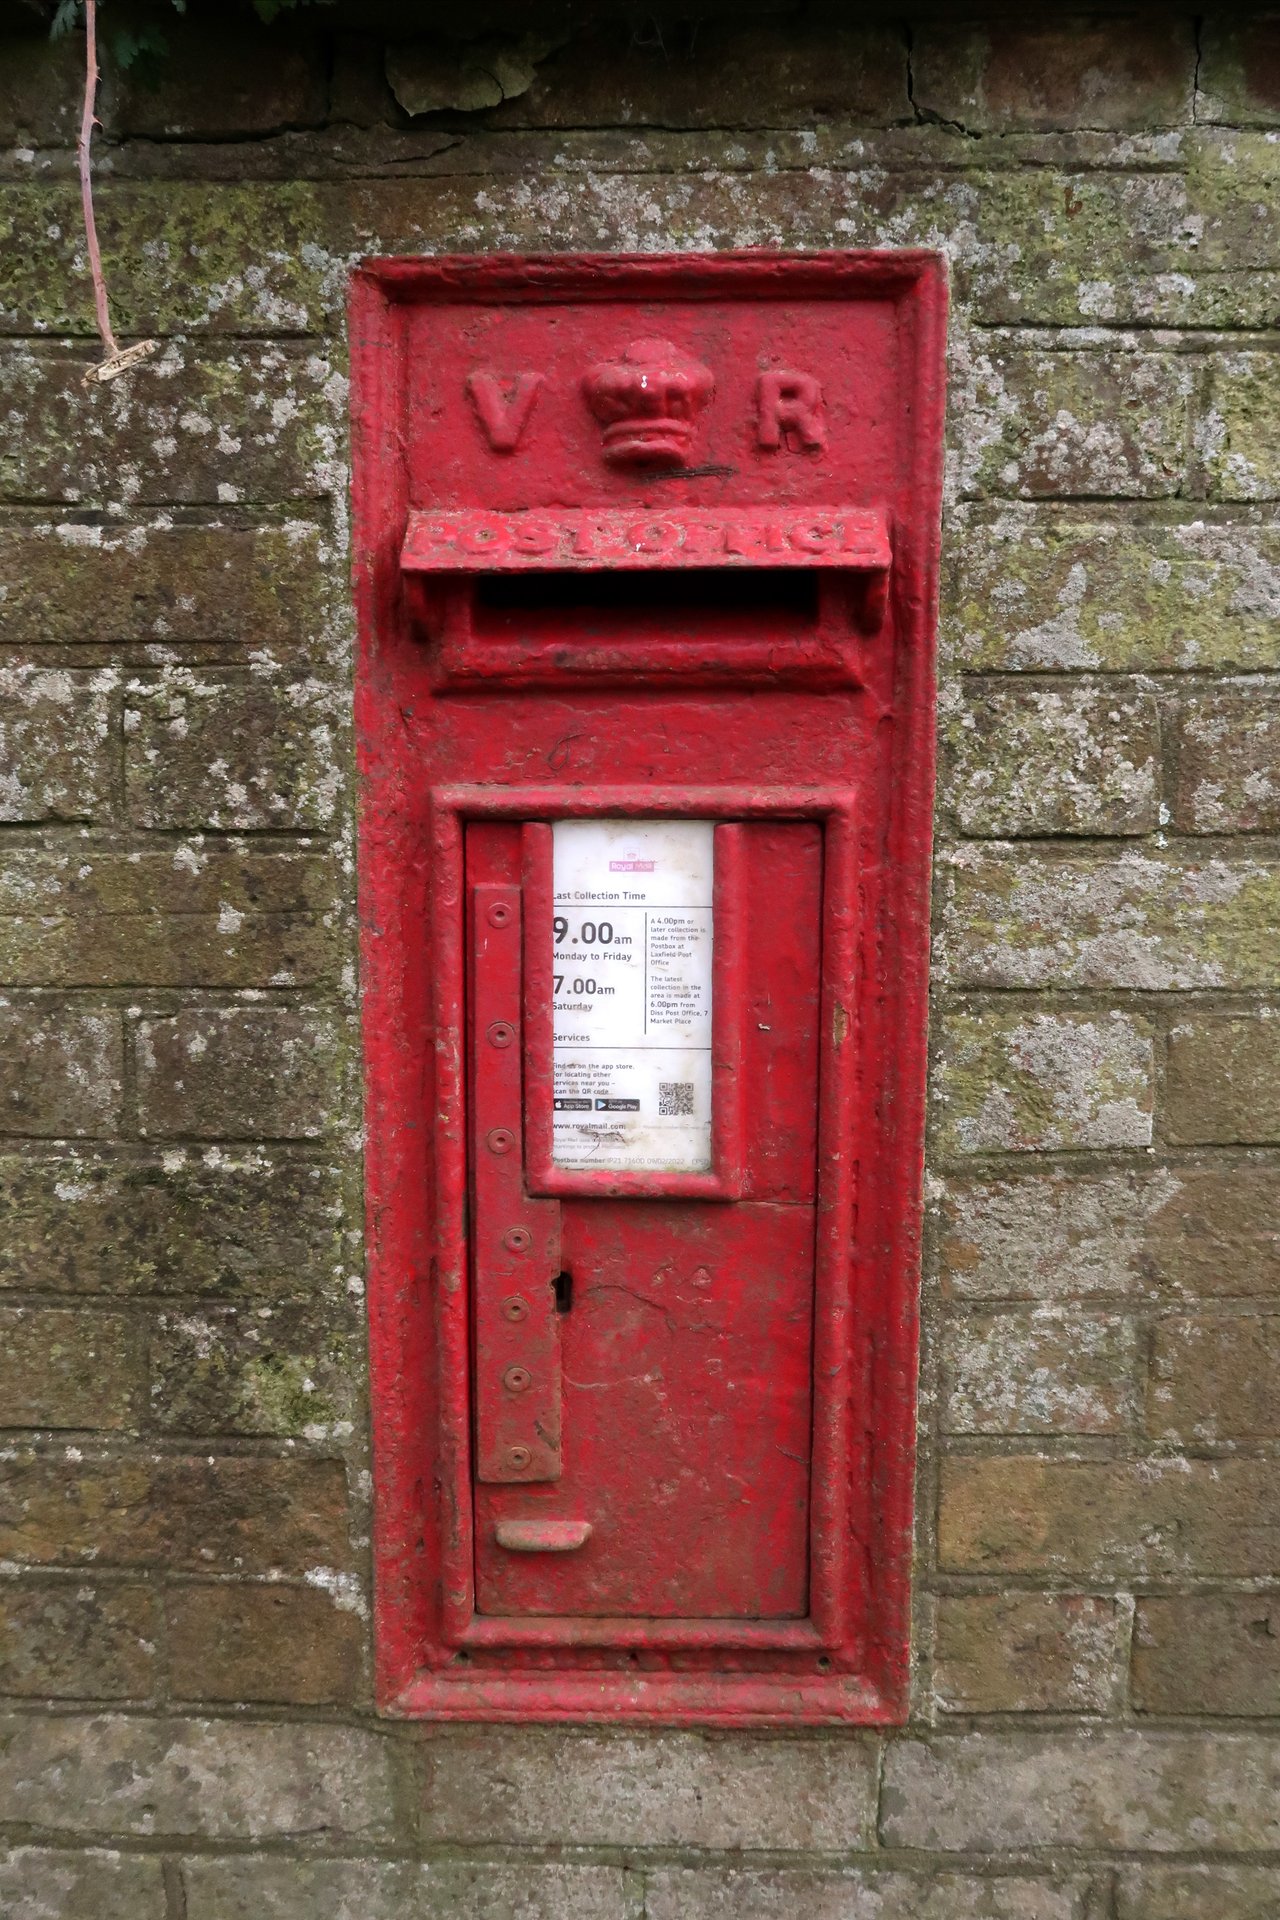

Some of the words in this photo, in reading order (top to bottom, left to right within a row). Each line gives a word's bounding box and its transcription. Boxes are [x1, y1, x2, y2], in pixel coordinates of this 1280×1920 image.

[465, 369, 547, 456] V
[756, 369, 828, 456] R
[412, 520, 596, 557] POST
[626, 520, 879, 557] OFFICE
[611, 863, 633, 871] Royal
[574, 891, 619, 900] Collection
[622, 892, 648, 900] Time
[657, 918, 685, 926] 4.00pm
[553, 917, 632, 944] 9.00am
[553, 952, 587, 961] Monday
[591, 952, 600, 960] to
[604, 952, 632, 961] Friday
[553, 975, 615, 994] 7.00am
[553, 1001, 593, 1012] Saturday
[651, 1001, 678, 1009] 6.00pm
[553, 1033, 590, 1041] Services
[602, 1064, 613, 1072] app
